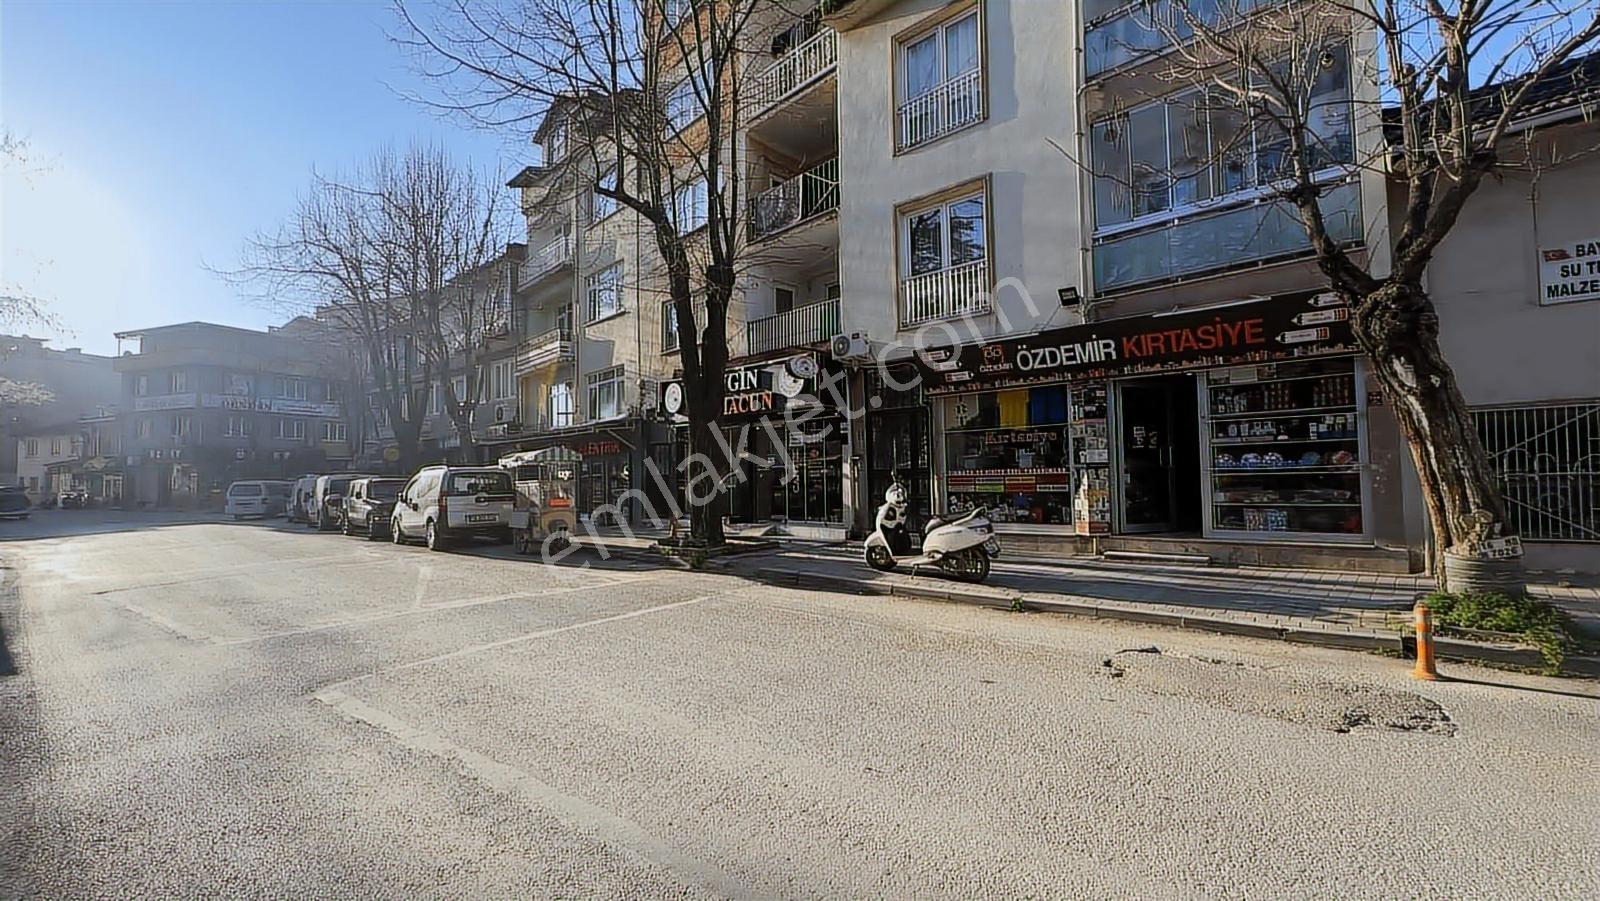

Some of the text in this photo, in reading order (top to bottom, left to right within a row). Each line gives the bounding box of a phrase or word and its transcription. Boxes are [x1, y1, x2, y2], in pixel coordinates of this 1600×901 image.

[1560, 263, 1581, 278] SU
[1547, 279, 1600, 299] MALZE
[1016, 334, 1117, 372] ÖZDEMİR
[1122, 316, 1266, 359] KIRTASİYE
